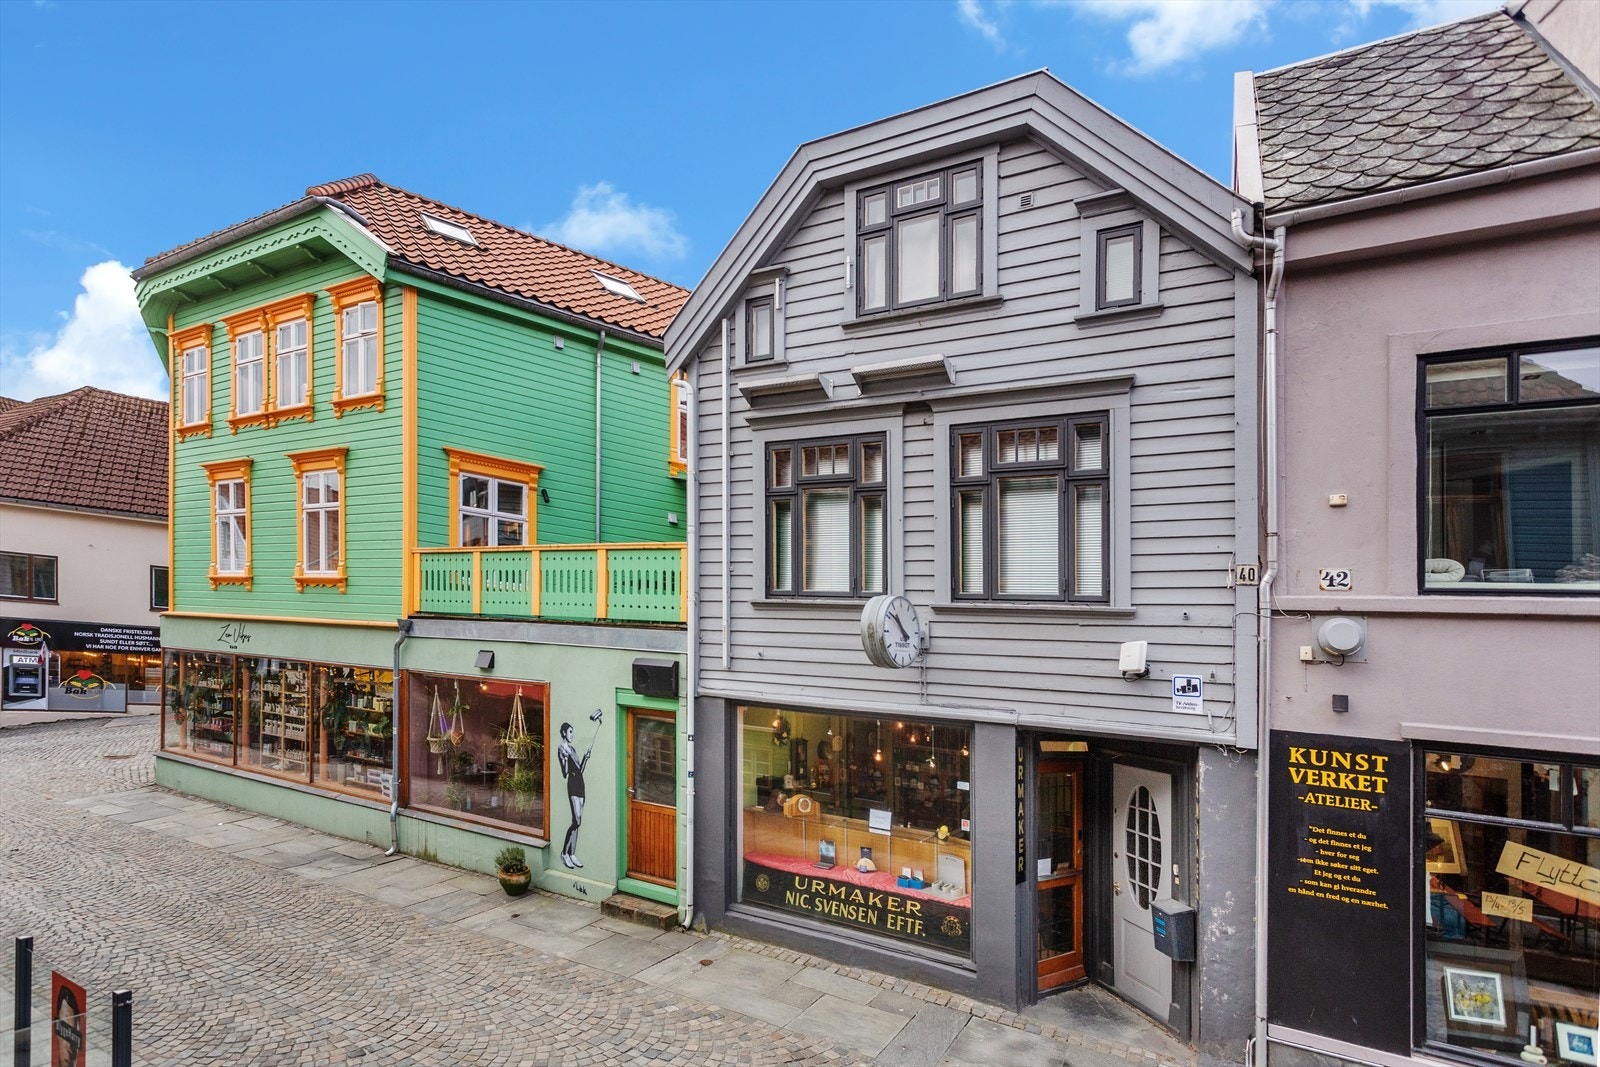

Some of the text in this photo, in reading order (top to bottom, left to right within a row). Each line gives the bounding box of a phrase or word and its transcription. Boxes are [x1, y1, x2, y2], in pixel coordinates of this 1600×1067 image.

[1239, 567, 1255, 582] 40
[1322, 571, 1350, 588] 42
[94, 632, 134, 640] TRADISJONELL
[64, 686, 88, 695] Bak
[1289, 746, 1389, 773] KUNST
[1288, 767, 1388, 794] VERKET
[1017, 746, 1025, 872] URMAKER
[1298, 792, 1378, 812] -ATELIER-
[1326, 828, 1348, 837] finnes
[1308, 837, 1317, 845] og
[1318, 838, 1329, 846] det
[1331, 840, 1352, 849] finnes
[1361, 844, 1372, 853] jeg
[1320, 848, 1335, 857] hver
[1336, 851, 1347, 859] for
[1349, 854, 1360, 862] seg
[1315, 858, 1329, 867] ikke
[1330, 862, 1349, 870] søker
[1350, 864, 1361, 872] sitt
[1362, 867, 1379, 875] eget.
[1322, 870, 1333, 879] jeg
[1333, 873, 1342, 881] og
[1351, 875, 1361, 883] du
[794, 876, 922, 917] URMAKER
[1320, 880, 1332, 889] kan
[1341, 884, 1377, 897] hverandre
[1297, 887, 1315, 896] hånd
[1325, 892, 1340, 901] fred
[1341, 896, 1350, 904] og
[1361, 900, 1389, 910] nærhet.
[785, 890, 811, 910] NIC.
[815, 897, 878, 926] SVENSEN
[886, 914, 926, 938] EFTF.
